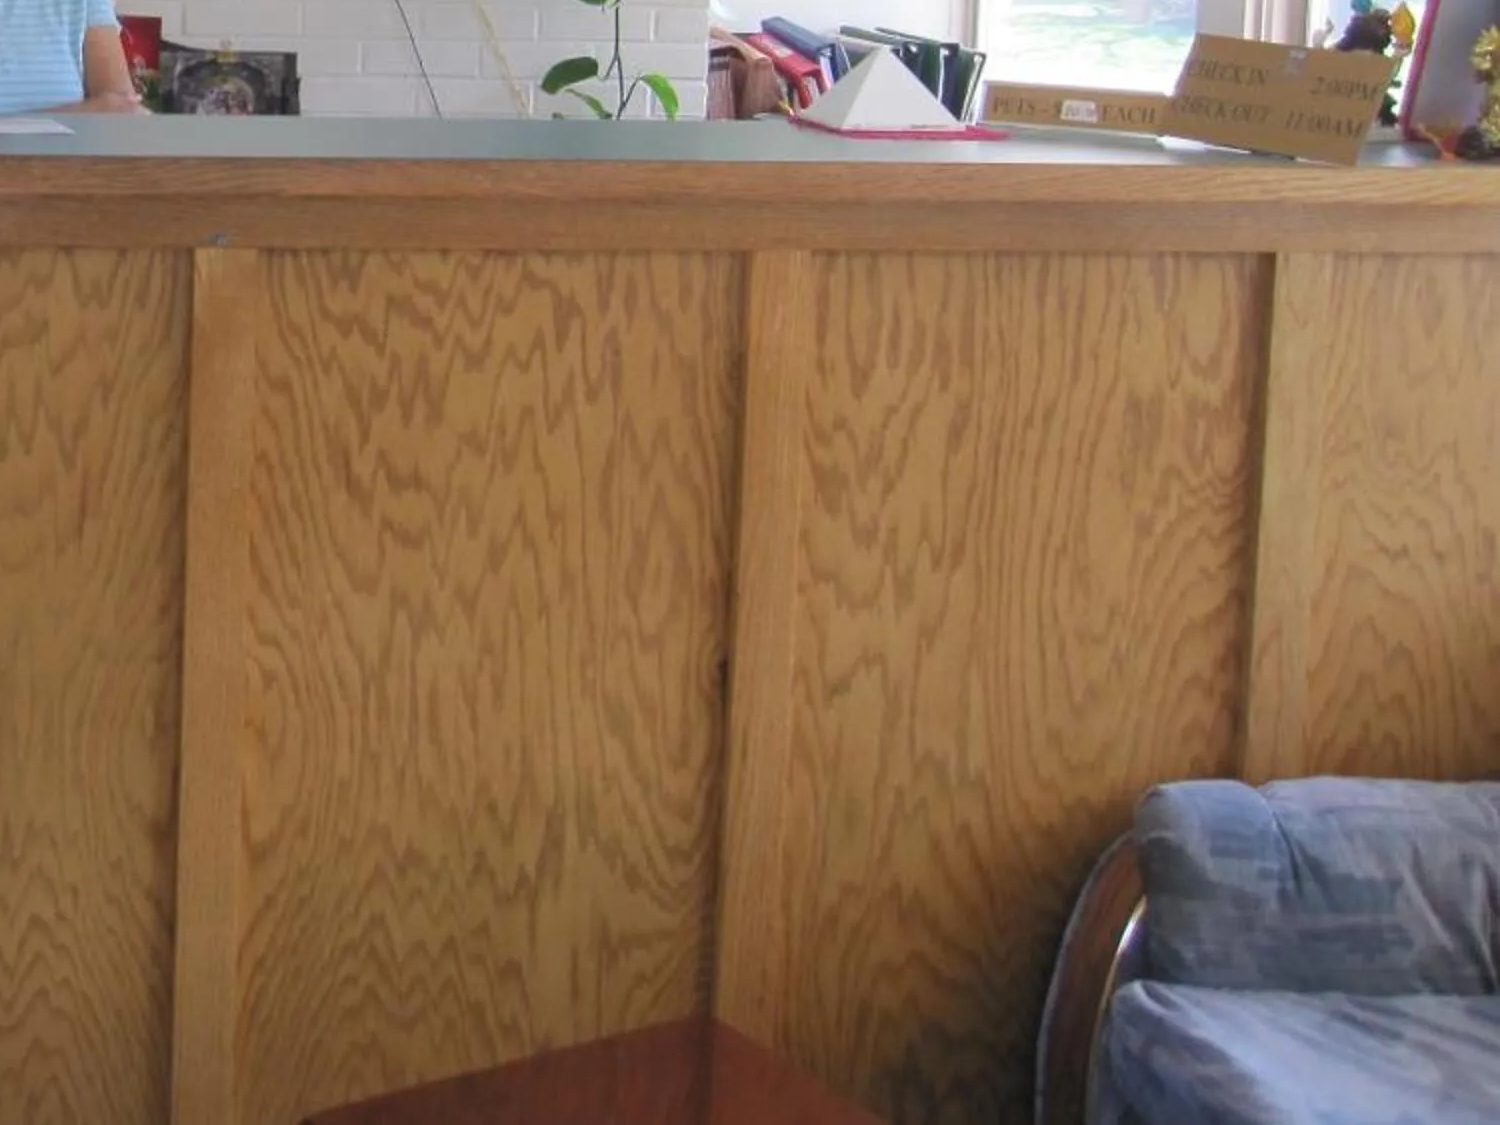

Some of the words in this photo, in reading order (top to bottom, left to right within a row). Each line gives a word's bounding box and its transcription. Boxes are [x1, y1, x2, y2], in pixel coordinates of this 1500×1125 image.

[1187, 58, 1241, 85] CHECK
[1245, 68, 1270, 87] IN
[993, 96, 1036, 117] PETS
[1102, 104, 1156, 125] EACH
[1171, 94, 1226, 121] CHECK
[1230, 103, 1270, 125] OUT
